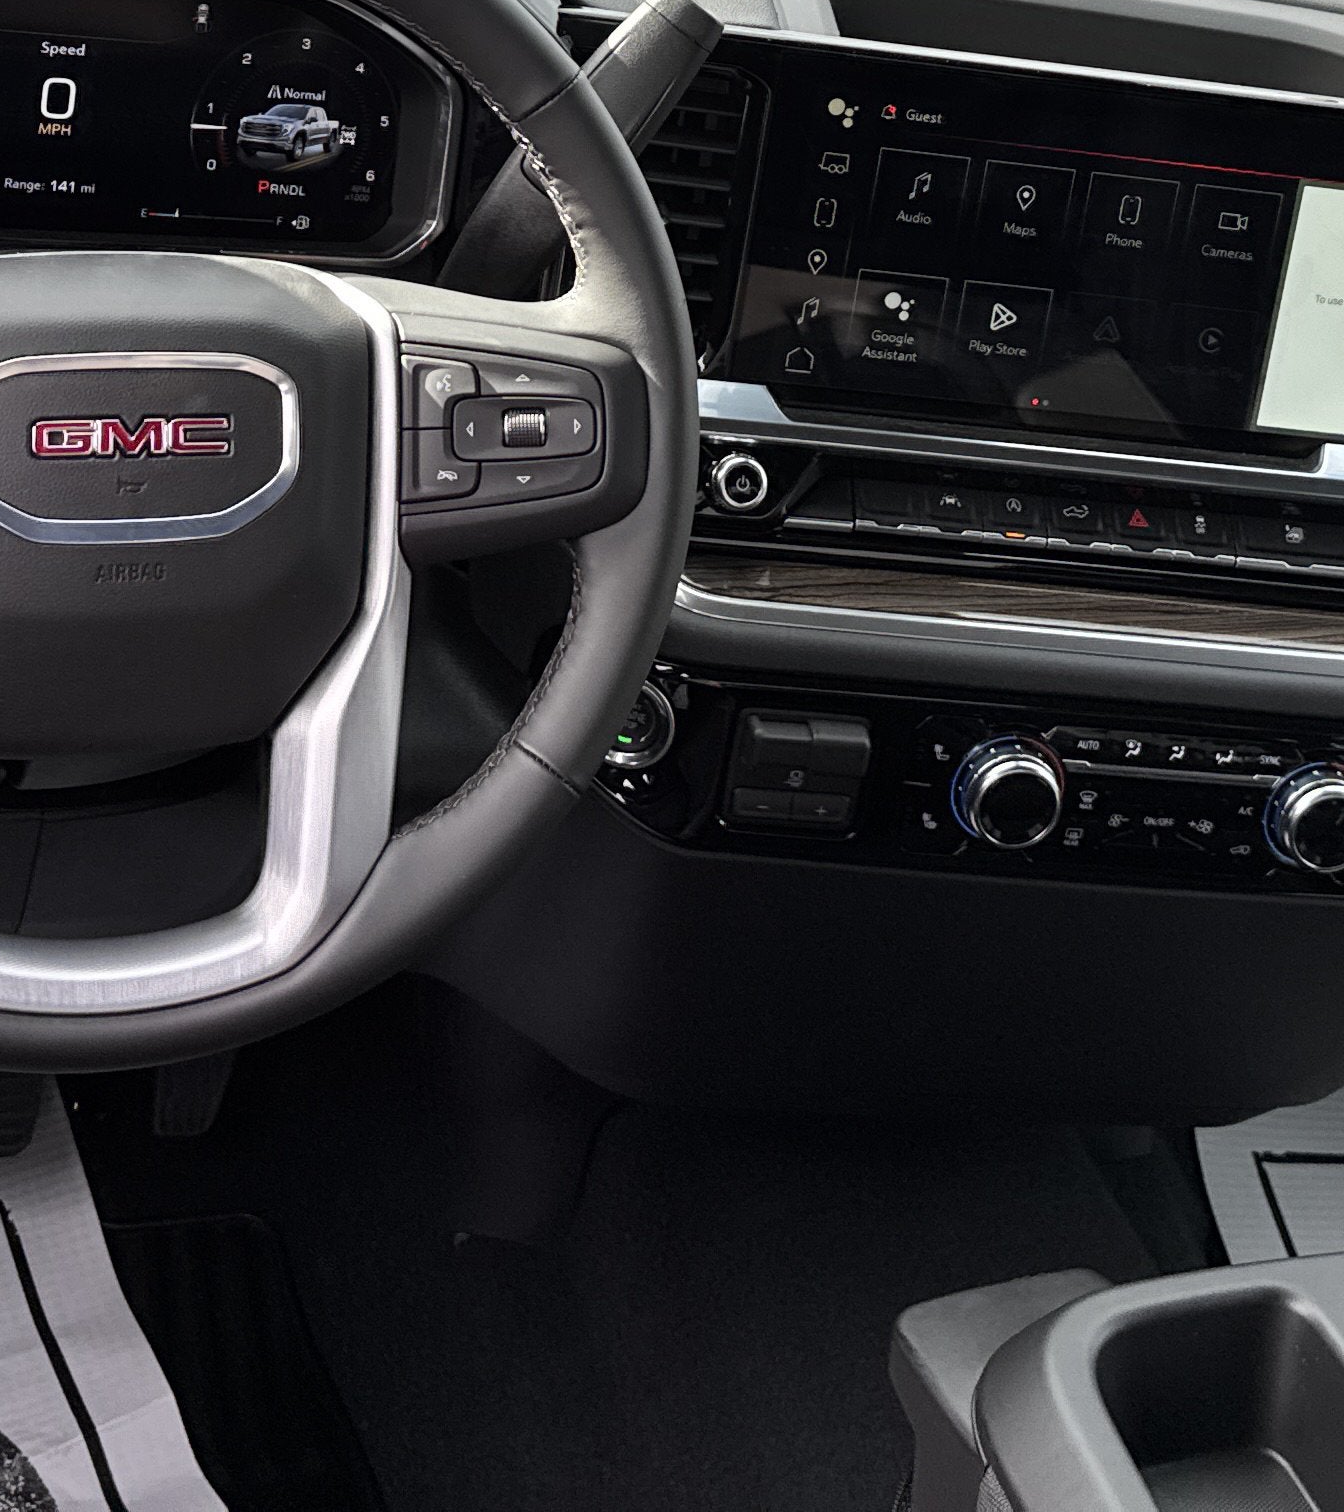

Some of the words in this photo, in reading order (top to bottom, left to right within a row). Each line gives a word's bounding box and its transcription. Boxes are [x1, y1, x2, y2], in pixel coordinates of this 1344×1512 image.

[40, 41, 86, 57] Speed
[301, 38, 312, 50] 3
[242, 53, 252, 65] 2
[355, 63, 366, 74] 4
[40, 77, 77, 119] 0
[283, 88, 326, 101] Normal
[207, 103, 214, 113] 1
[380, 116, 389, 127] 5
[906, 109, 943, 124] Guest
[38, 123, 72, 136] MPH
[206, 159, 217, 170] 0
[366, 170, 375, 181] 6
[4, 178, 45, 193] Range:
[50, 180, 75, 193] 141
[80, 183, 95, 194] mi
[896, 210, 932, 225] Audio
[1003, 222, 1037, 237] Maps
[1105, 234, 1143, 249] Phone
[1201, 244, 1253, 262] Cameras
[1315, 294, 1325, 305] To
[1328, 297, 1344, 307] use
[871, 329, 915, 347] Google
[862, 347, 918, 363] Assistant
[969, 339, 993, 355] Play
[995, 343, 1027, 357] Store
[31, 415, 231, 458] GMC
[93, 562, 168, 584] AIRBAG
[1077, 740, 1100, 751] AUTO
[1260, 755, 1282, 766] SYNC
